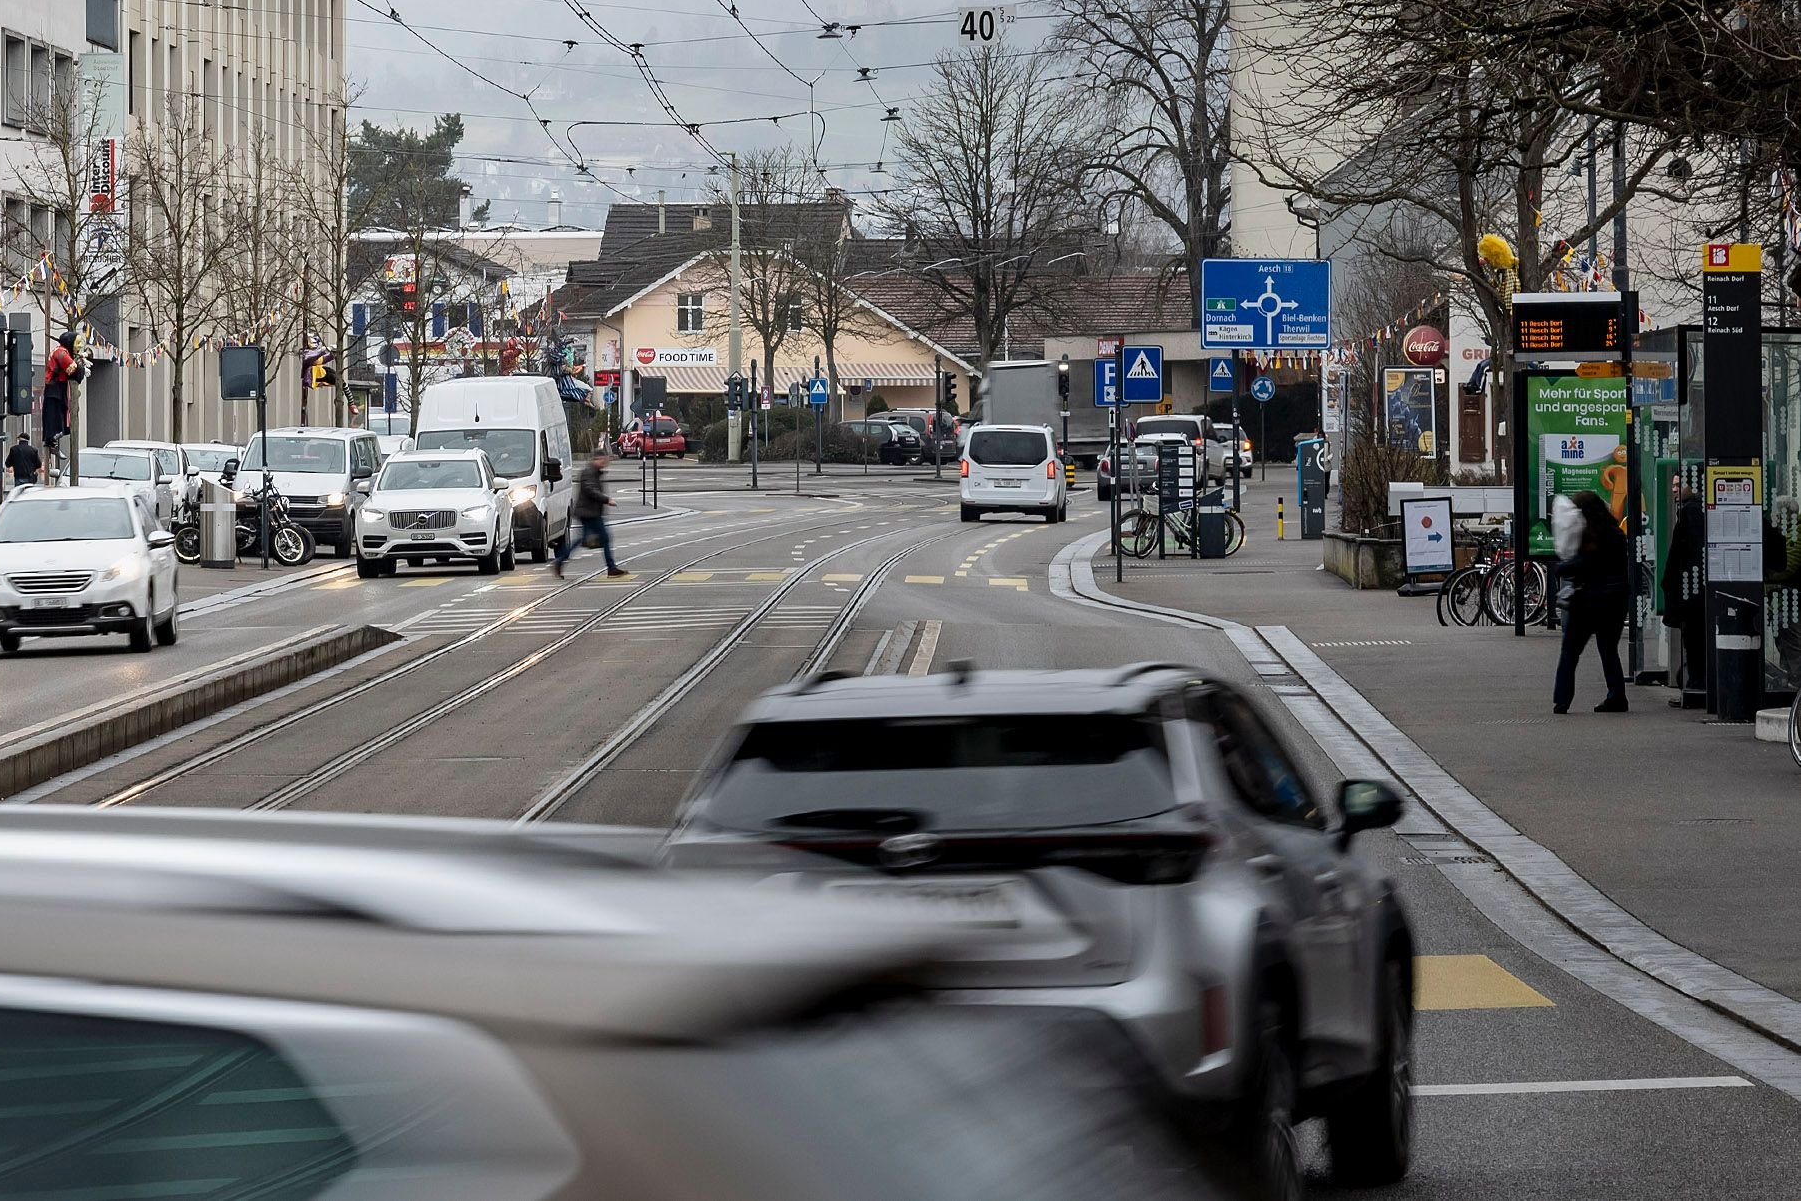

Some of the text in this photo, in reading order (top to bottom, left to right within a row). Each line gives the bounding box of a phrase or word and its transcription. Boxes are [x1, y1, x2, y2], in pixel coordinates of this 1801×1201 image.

[960, 10, 995, 41] 40
[100, 138, 111, 194] Discount
[91, 162, 101, 194] Inter
[1259, 264, 1292, 273] Aesch 18
[1707, 295, 1717, 304] 11
[1206, 314, 1237, 322] Dornach
[1282, 314, 1327, 322] Biel-Benken
[1707, 317, 1718, 326] 12
[1283, 325, 1310, 333] Therwil
[659, 353, 714, 362] FOOD TIME
[1539, 387, 1627, 402] Mehr für Sport
[1535, 401, 1627, 415] und angespan
[1575, 415, 1609, 426] Fans.
[1561, 449, 1584, 459] mine
[1561, 467, 1598, 476] Magnesium
